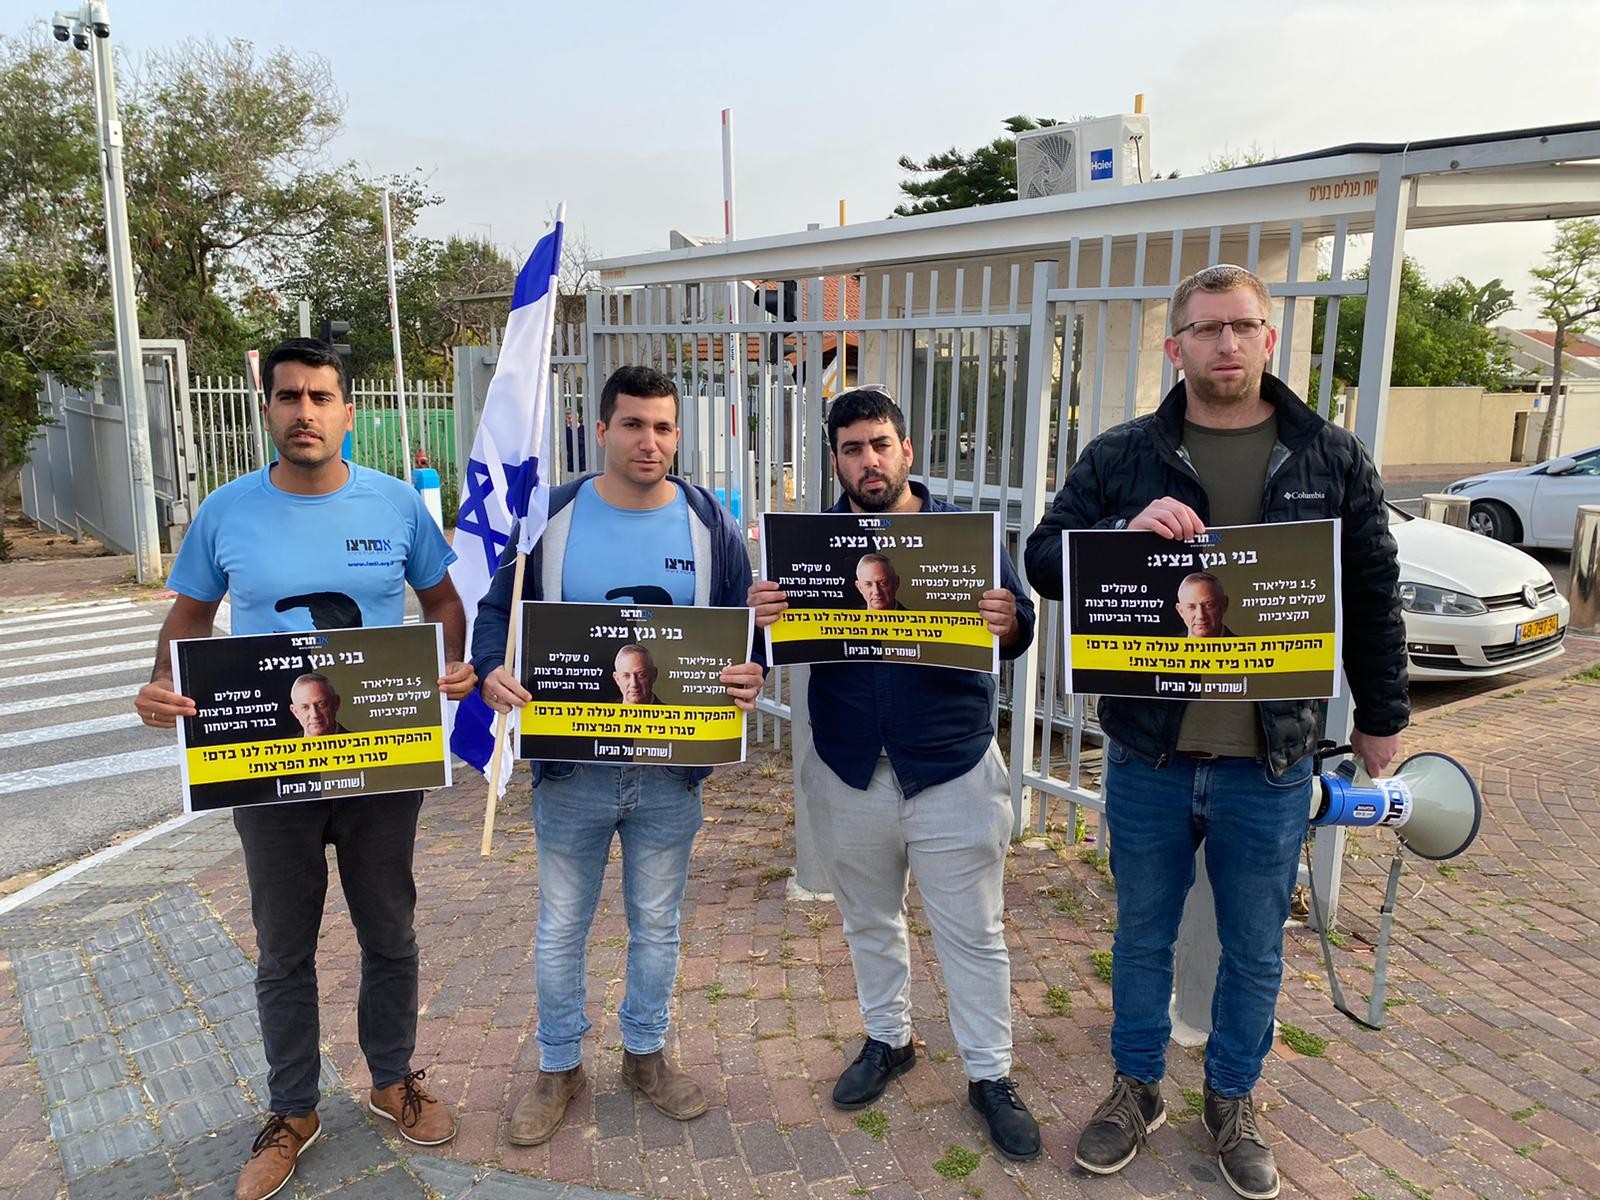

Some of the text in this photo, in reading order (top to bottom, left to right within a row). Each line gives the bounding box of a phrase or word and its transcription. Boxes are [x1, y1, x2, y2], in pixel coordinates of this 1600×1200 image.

[1091, 160, 1112, 170] Haier
[1335, 180, 1360, 199] פנלים
[1291, 491, 1325, 500] Columbia
[830, 536, 923, 550] בני גנץ מציג:
[1148, 551, 1257, 568] בני גנץ מציג:
[792, 563, 822, 573] שקלים
[920, 564, 976, 574] 1.5 מיליארד
[778, 577, 845, 585] לסתימת פרצות
[912, 578, 985, 588] שקלים לפנסיות
[1253, 579, 1316, 590] 1.5 מיליארד
[783, 590, 819, 598] הביטחו
[1102, 584, 1147, 594] 0 שקלים
[927, 593, 970, 601] תקציביות
[1242, 594, 1325, 607] שקלים לפנסיות
[1085, 599, 1163, 608] לסתימת פרצות
[783, 612, 984, 626] ההפקרות הביטחונית עולה לנו בדם!
[1089, 614, 1131, 623] הביטחון
[1259, 611, 1309, 621] תקציביות
[590, 626, 682, 641] בני גנץ מציג:
[821, 626, 867, 635] הפרצות!
[892, 628, 912, 636] מיד
[917, 629, 942, 637] סגרו
[871, 646, 882, 655] על
[1087, 639, 1322, 652] ההפקרות הביטחונית עולה לנו בדם!
[885, 648, 916, 656] שומרים
[259, 652, 364, 671] בני גנץ מציג:
[549, 653, 580, 663] שקלים
[678, 656, 732, 668] 1.5 מיליארד
[1130, 657, 1274, 668] סגרו מיד את הפרצות!
[534, 667, 603, 676] לסתימת פרצות
[669, 671, 706, 679] לפנסיות
[361, 677, 421, 688] 1.5 מיליארד
[538, 681, 599, 690] בגדר הביטחון
[1161, 681, 1242, 692] שומרים על הבית
[682, 685, 725, 694] תקציביות
[215, 690, 261, 701] 0 שקלים
[353, 691, 430, 704] שקלים לפנסיות
[199, 702, 278, 717] לסתימת פרצות
[370, 707, 417, 717] תקציביות
[535, 706, 735, 722] ההפקרות הביטחונית עולה לנו בדם!
[204, 718, 276, 733] בגדר הביטחון
[573, 722, 695, 735] סגרו מיד את הפרצות!
[203, 732, 431, 761] ההפקרות הביטחונית עולה לנו בדם!
[599, 745, 667, 757] שומרים על הבית
[249, 752, 387, 773] סגרו מיד את הפרצות!
[283, 778, 359, 794] שומרים על הבית
